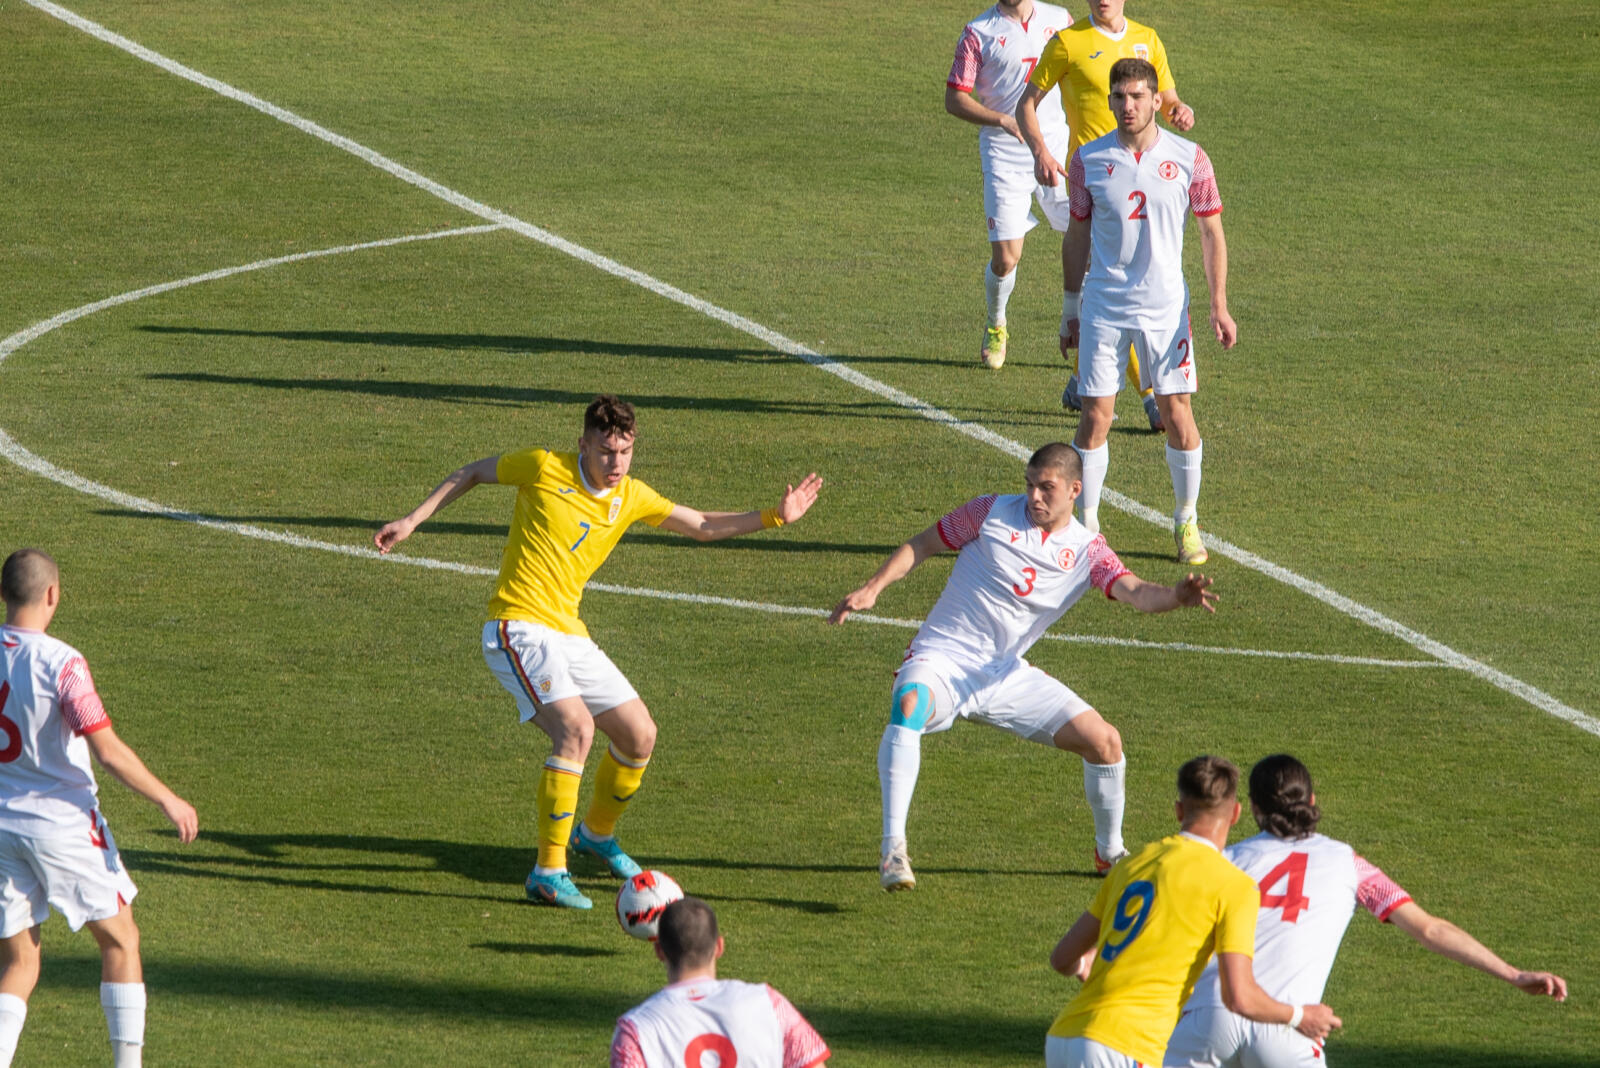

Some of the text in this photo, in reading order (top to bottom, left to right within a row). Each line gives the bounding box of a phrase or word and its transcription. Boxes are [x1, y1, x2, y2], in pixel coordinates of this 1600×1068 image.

[1021, 57, 1038, 84] 7
[1127, 190, 1148, 220] 2
[1177, 338, 1191, 368] 2
[569, 521, 590, 552] 7
[1012, 566, 1037, 597] 3
[1258, 851, 1309, 924] 4
[1101, 880, 1155, 962] 9
